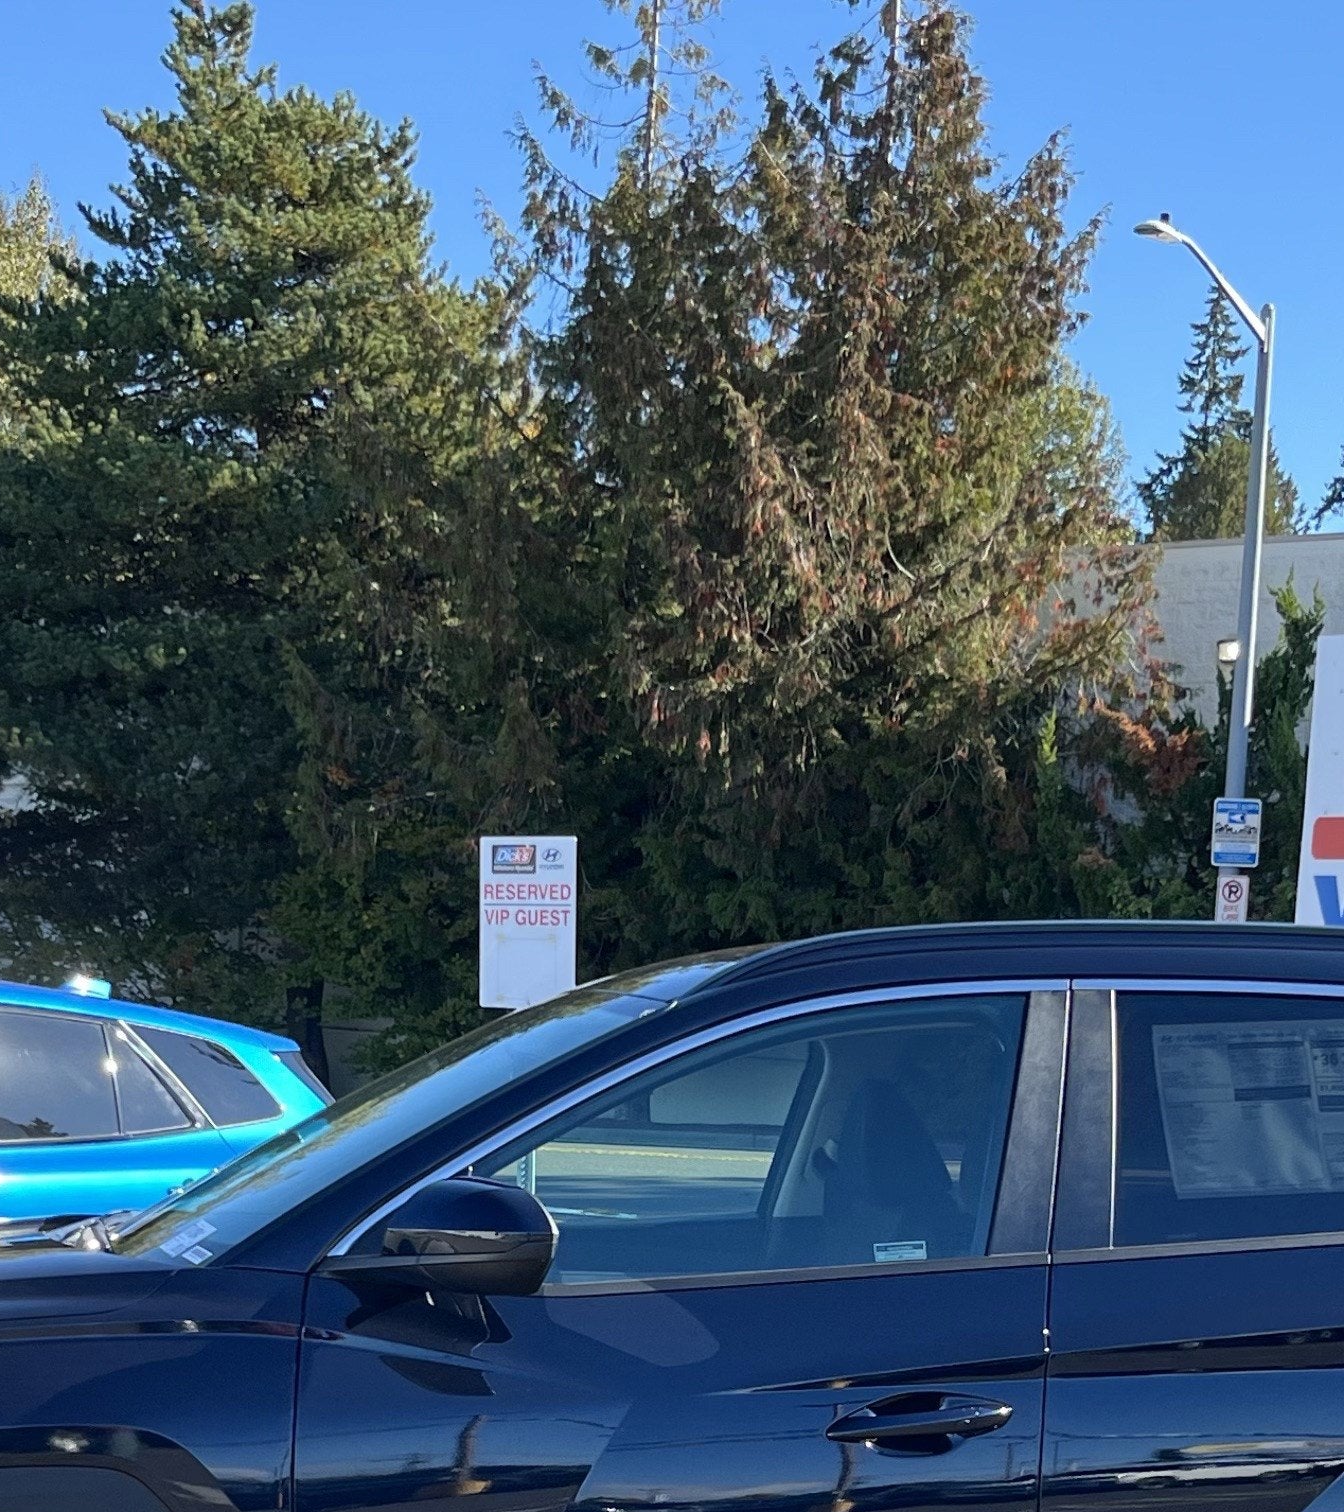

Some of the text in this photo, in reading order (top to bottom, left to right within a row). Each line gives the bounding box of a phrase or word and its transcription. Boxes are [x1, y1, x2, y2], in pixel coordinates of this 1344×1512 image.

[484, 883, 572, 901] RESERVED
[484, 909, 571, 927] VIP GUEST
